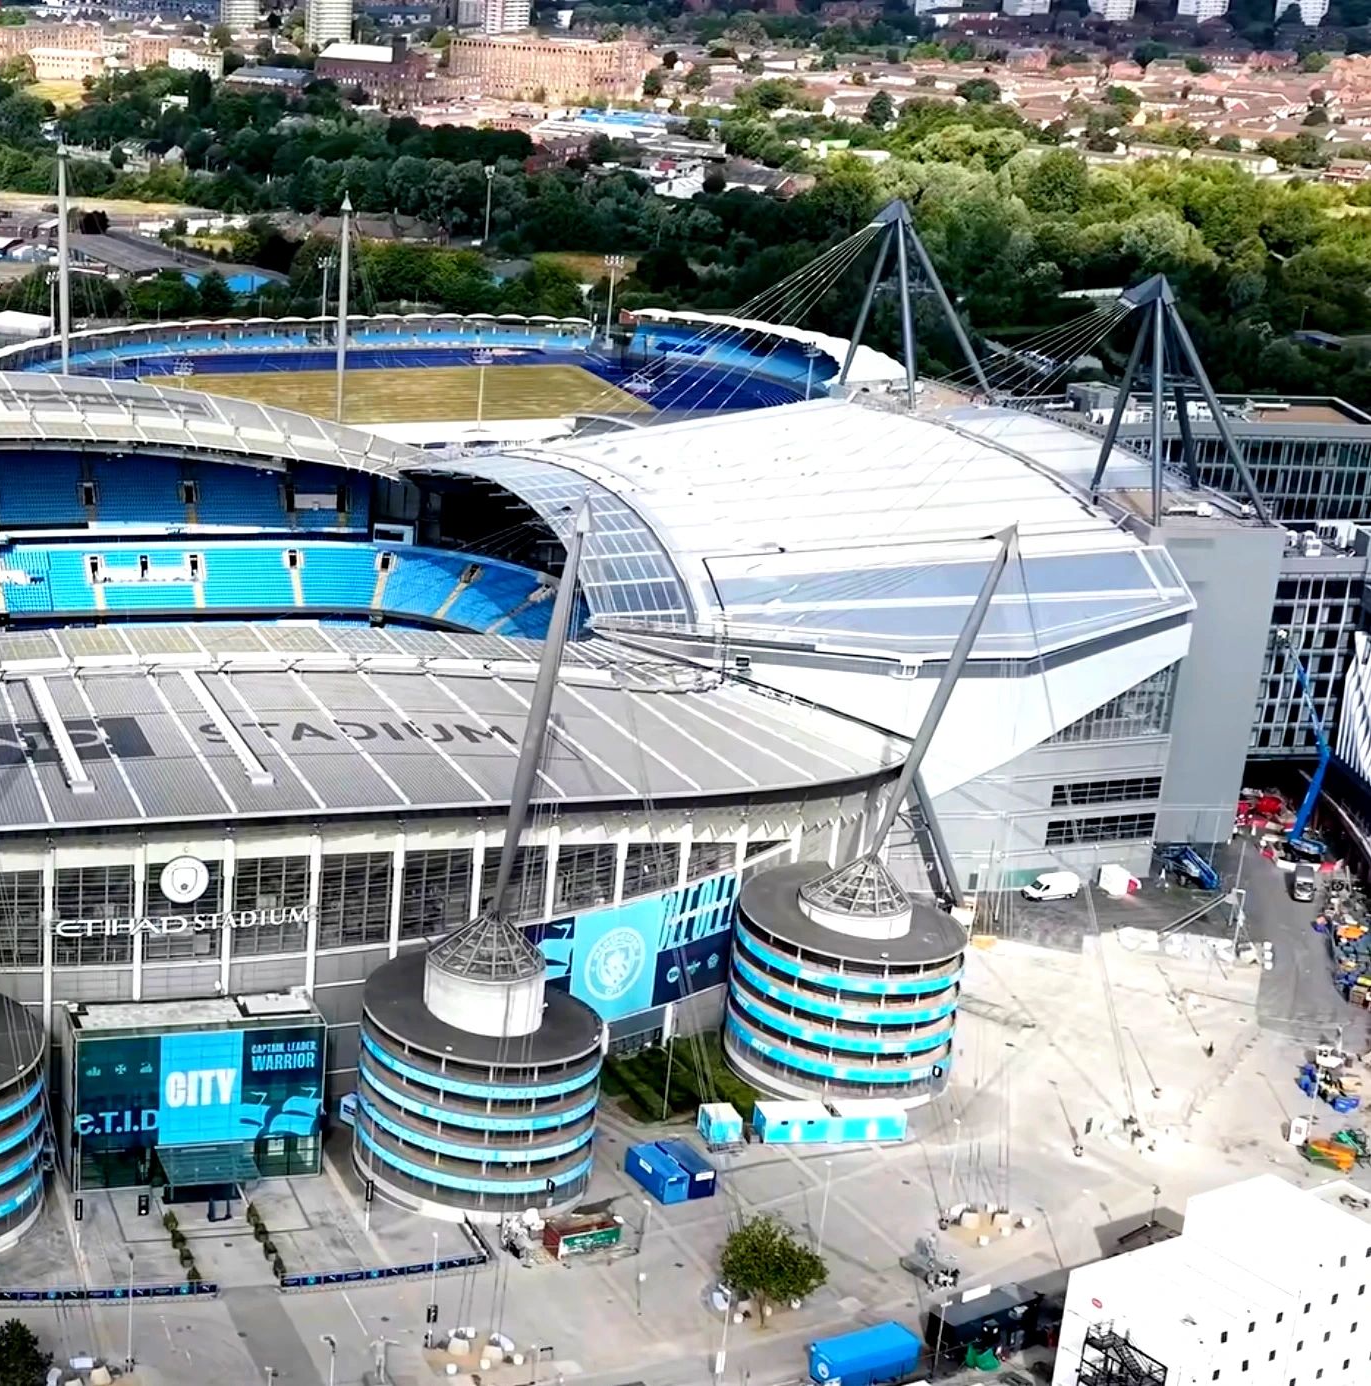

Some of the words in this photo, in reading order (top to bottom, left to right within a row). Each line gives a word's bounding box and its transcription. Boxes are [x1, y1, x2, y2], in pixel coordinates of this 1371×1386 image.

[198, 719, 519, 746] STADIUM
[55, 915, 188, 938] ETIHAD
[193, 905, 310, 932] STADIUM
[251, 1051, 316, 1071] WARRIOR
[165, 1068, 238, 1109] CITY
